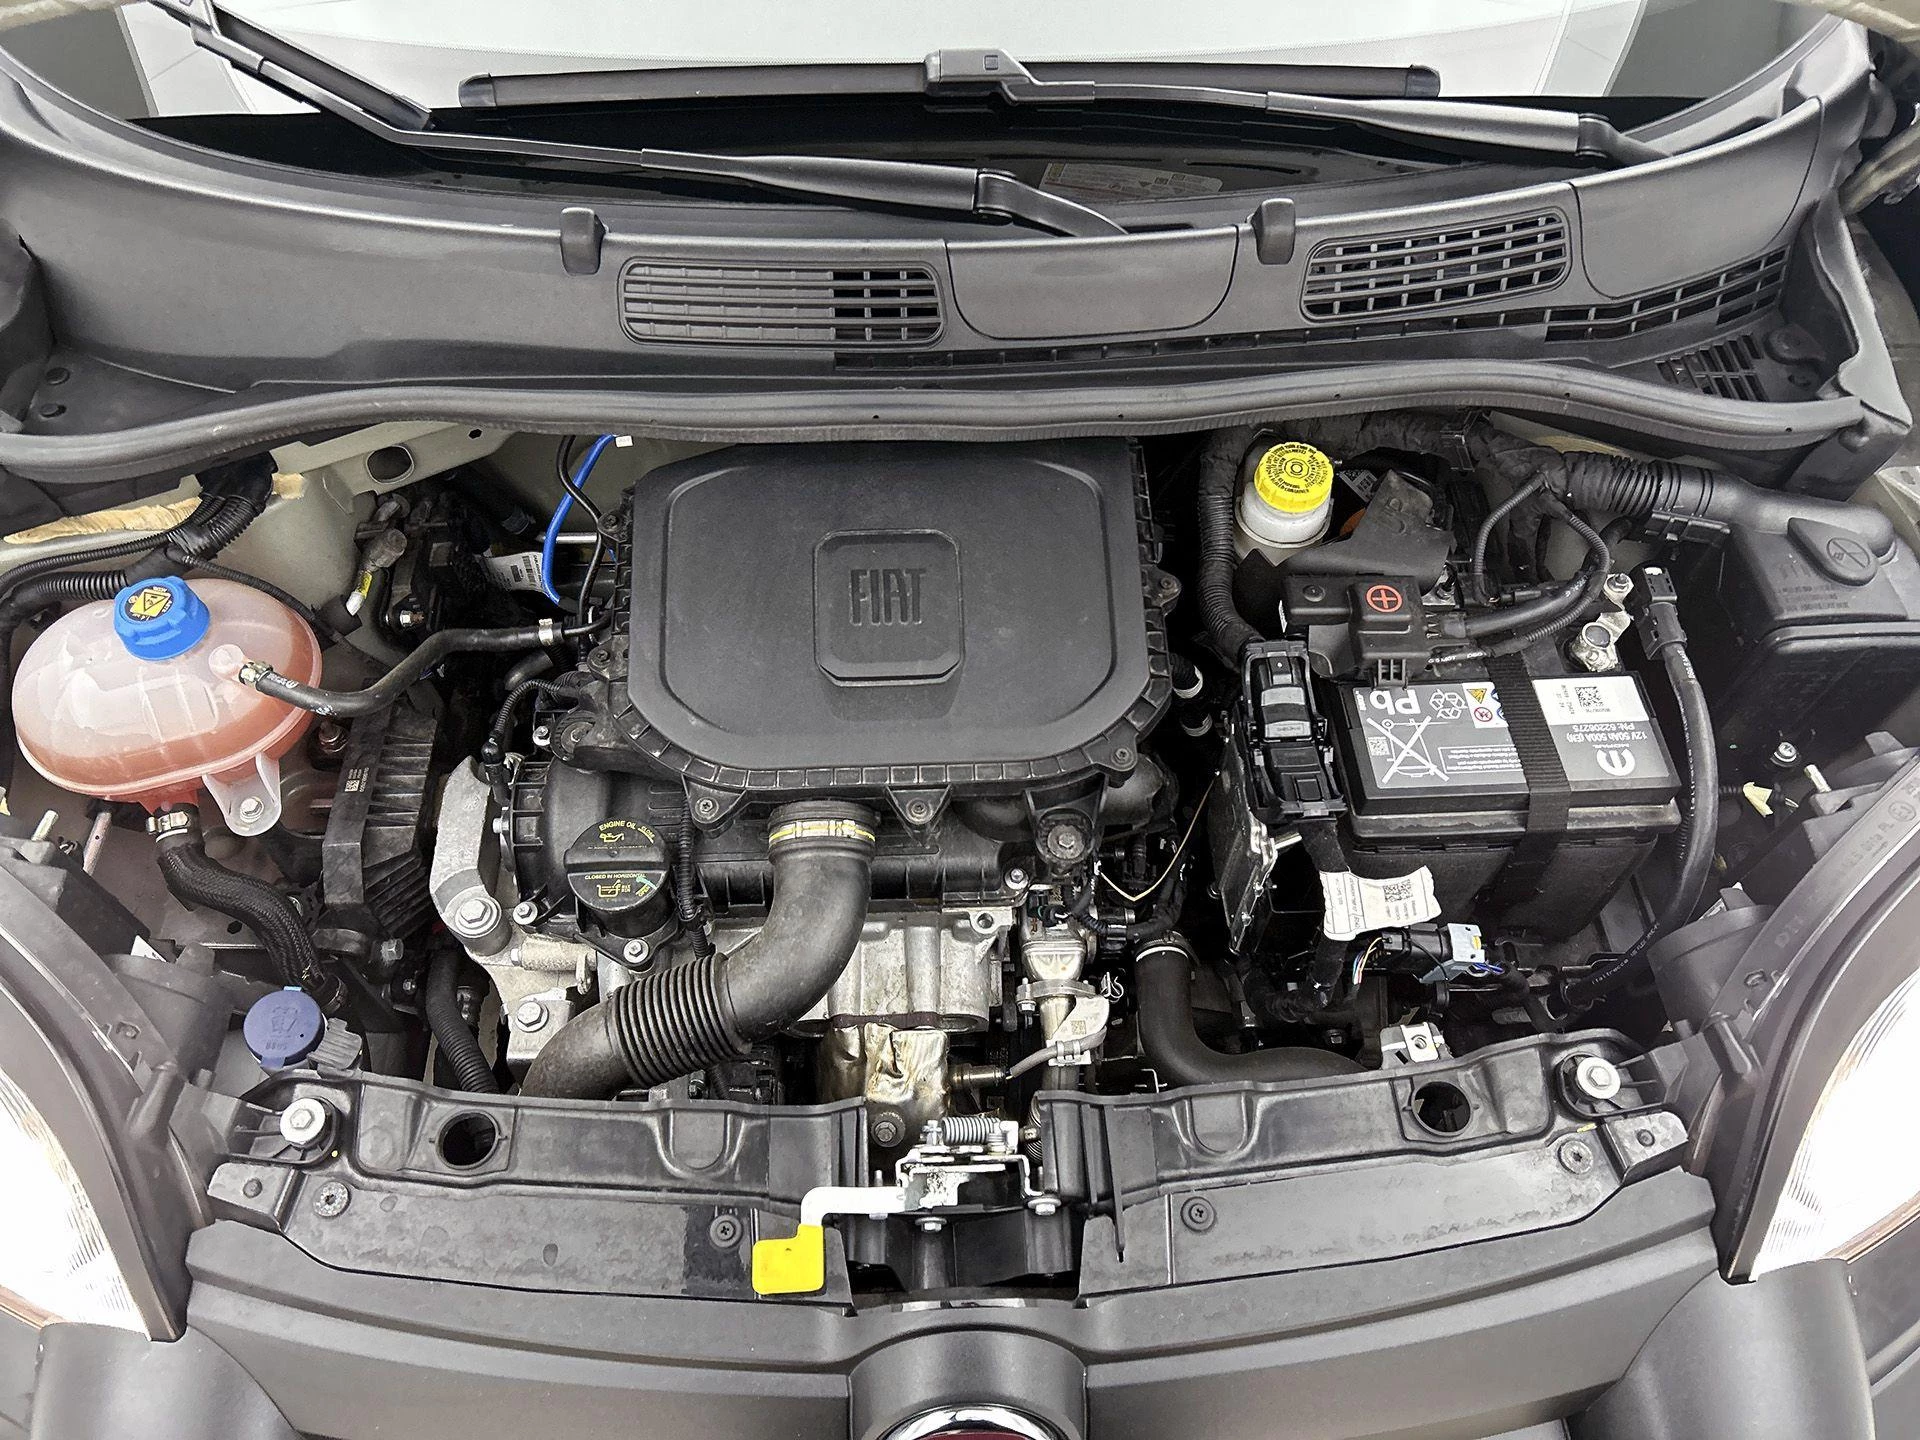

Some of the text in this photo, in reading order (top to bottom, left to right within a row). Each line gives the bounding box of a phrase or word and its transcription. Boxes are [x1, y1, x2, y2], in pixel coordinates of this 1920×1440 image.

[849, 568, 926, 626] FIAT
[1369, 689, 1421, 716] Pb
[1584, 732, 1608, 742] 500A
[599, 820, 637, 832] ENGINE OIL
